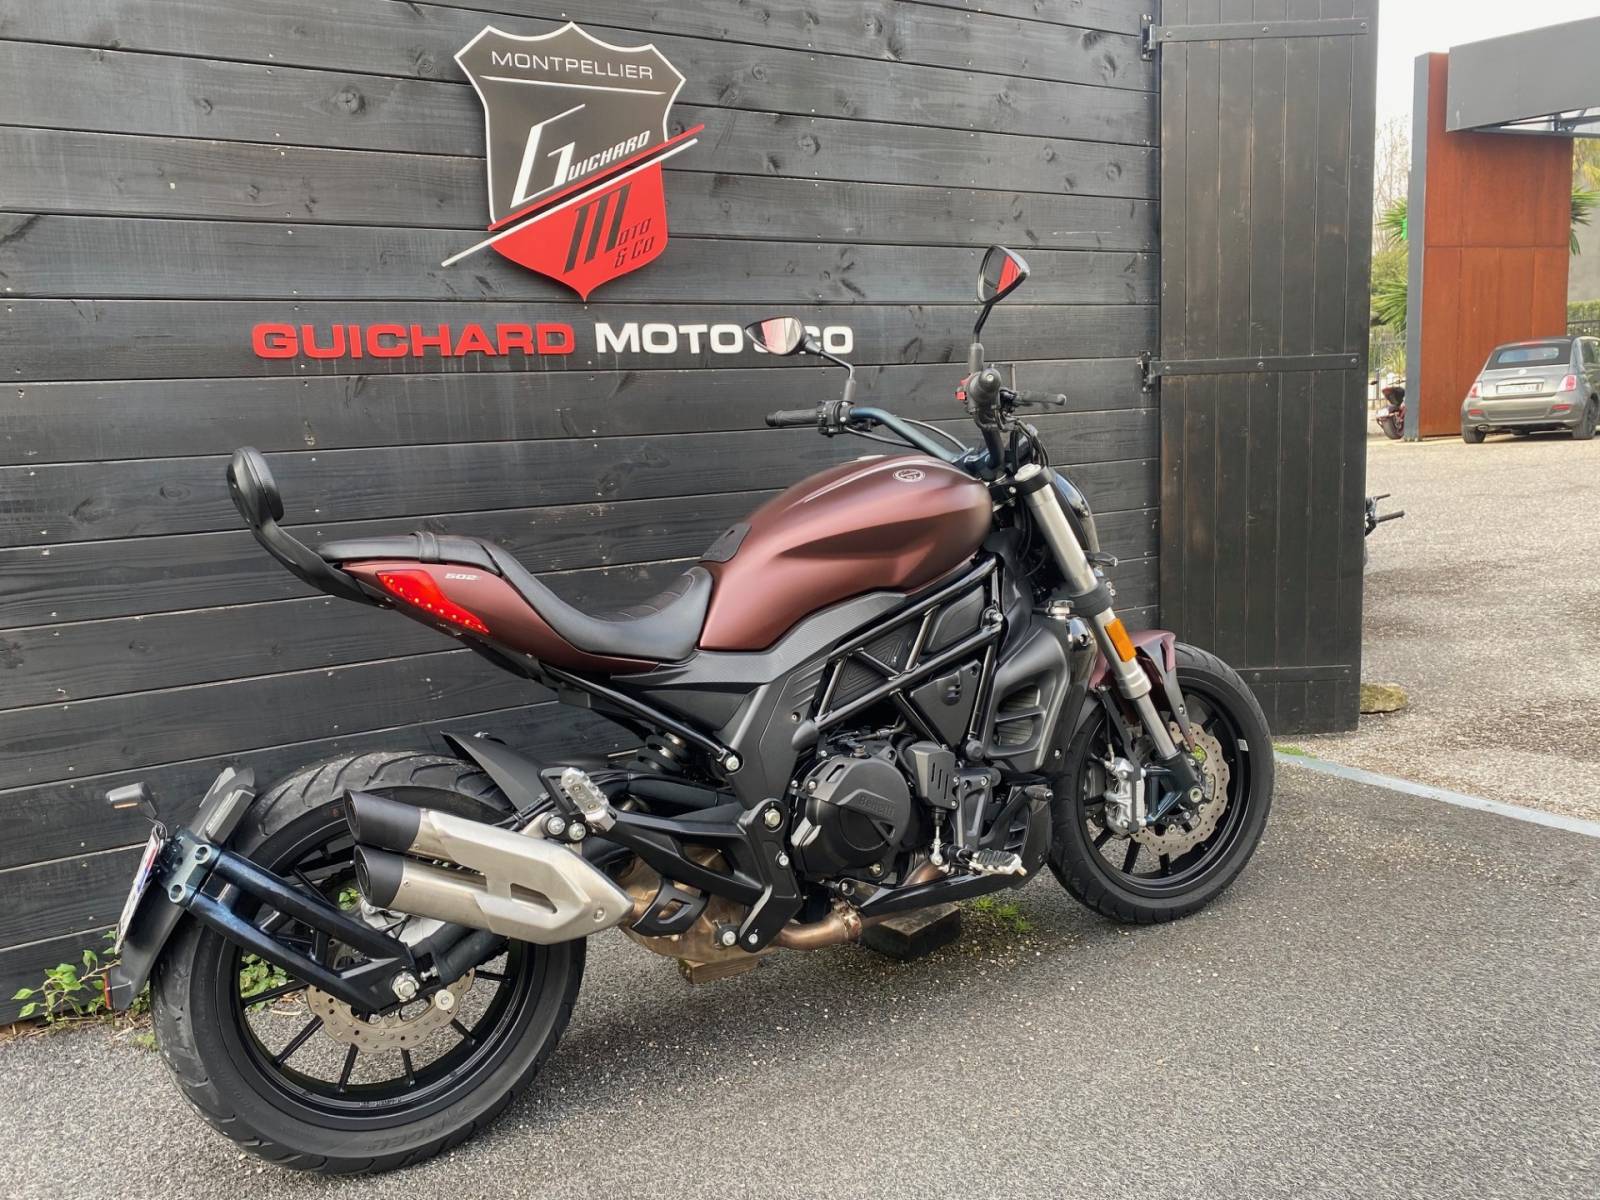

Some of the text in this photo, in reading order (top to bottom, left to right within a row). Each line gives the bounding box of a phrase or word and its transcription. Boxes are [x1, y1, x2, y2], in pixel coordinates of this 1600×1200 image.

[491, 50, 653, 80] MONTPELLIER
[631, 236, 655, 259] CO
[252, 323, 575, 359] GUICHARD
[595, 322, 743, 354] MOTO
